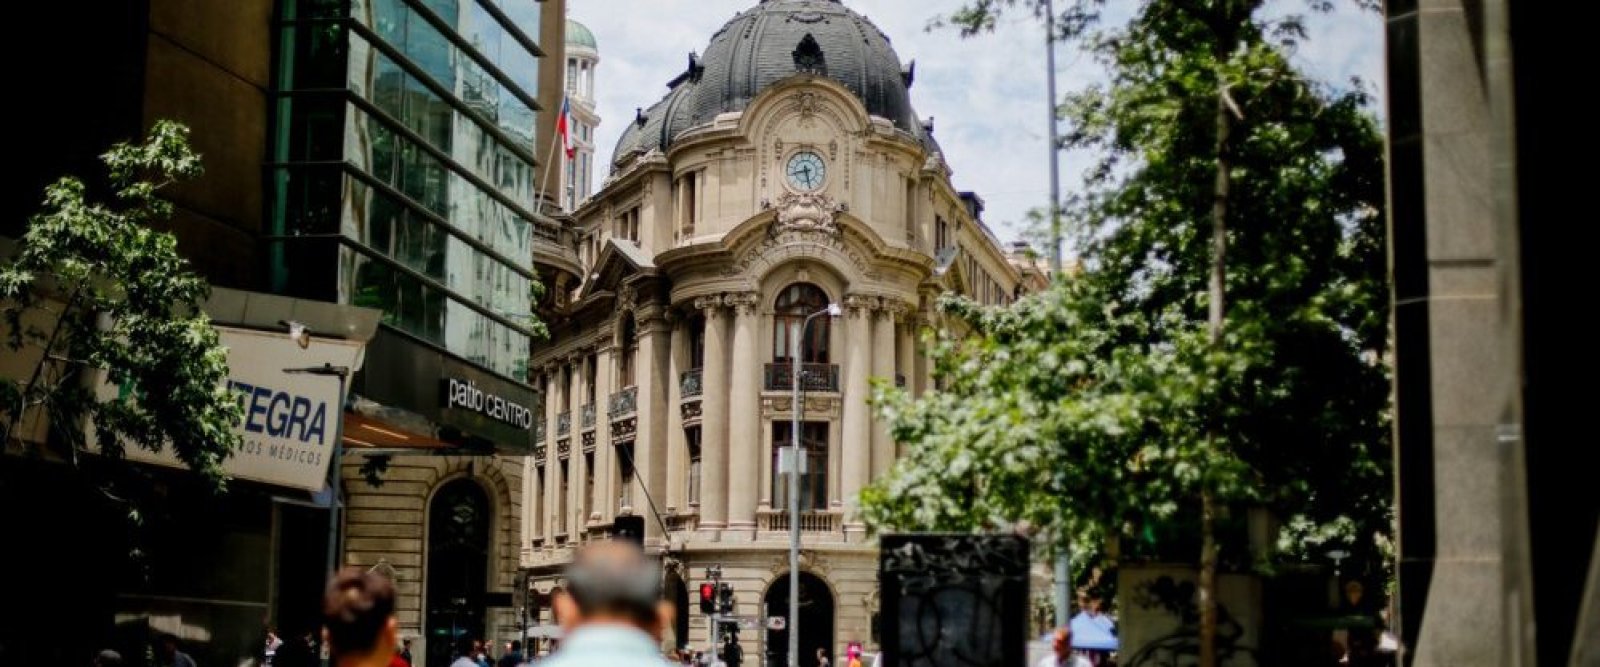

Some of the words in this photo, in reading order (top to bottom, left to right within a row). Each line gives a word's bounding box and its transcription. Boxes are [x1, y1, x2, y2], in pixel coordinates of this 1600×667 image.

[227, 379, 327, 446] TEGRA
[448, 378, 483, 412] patio
[485, 394, 533, 430] CENTRO
[268, 444, 321, 467] MÉDICOS
